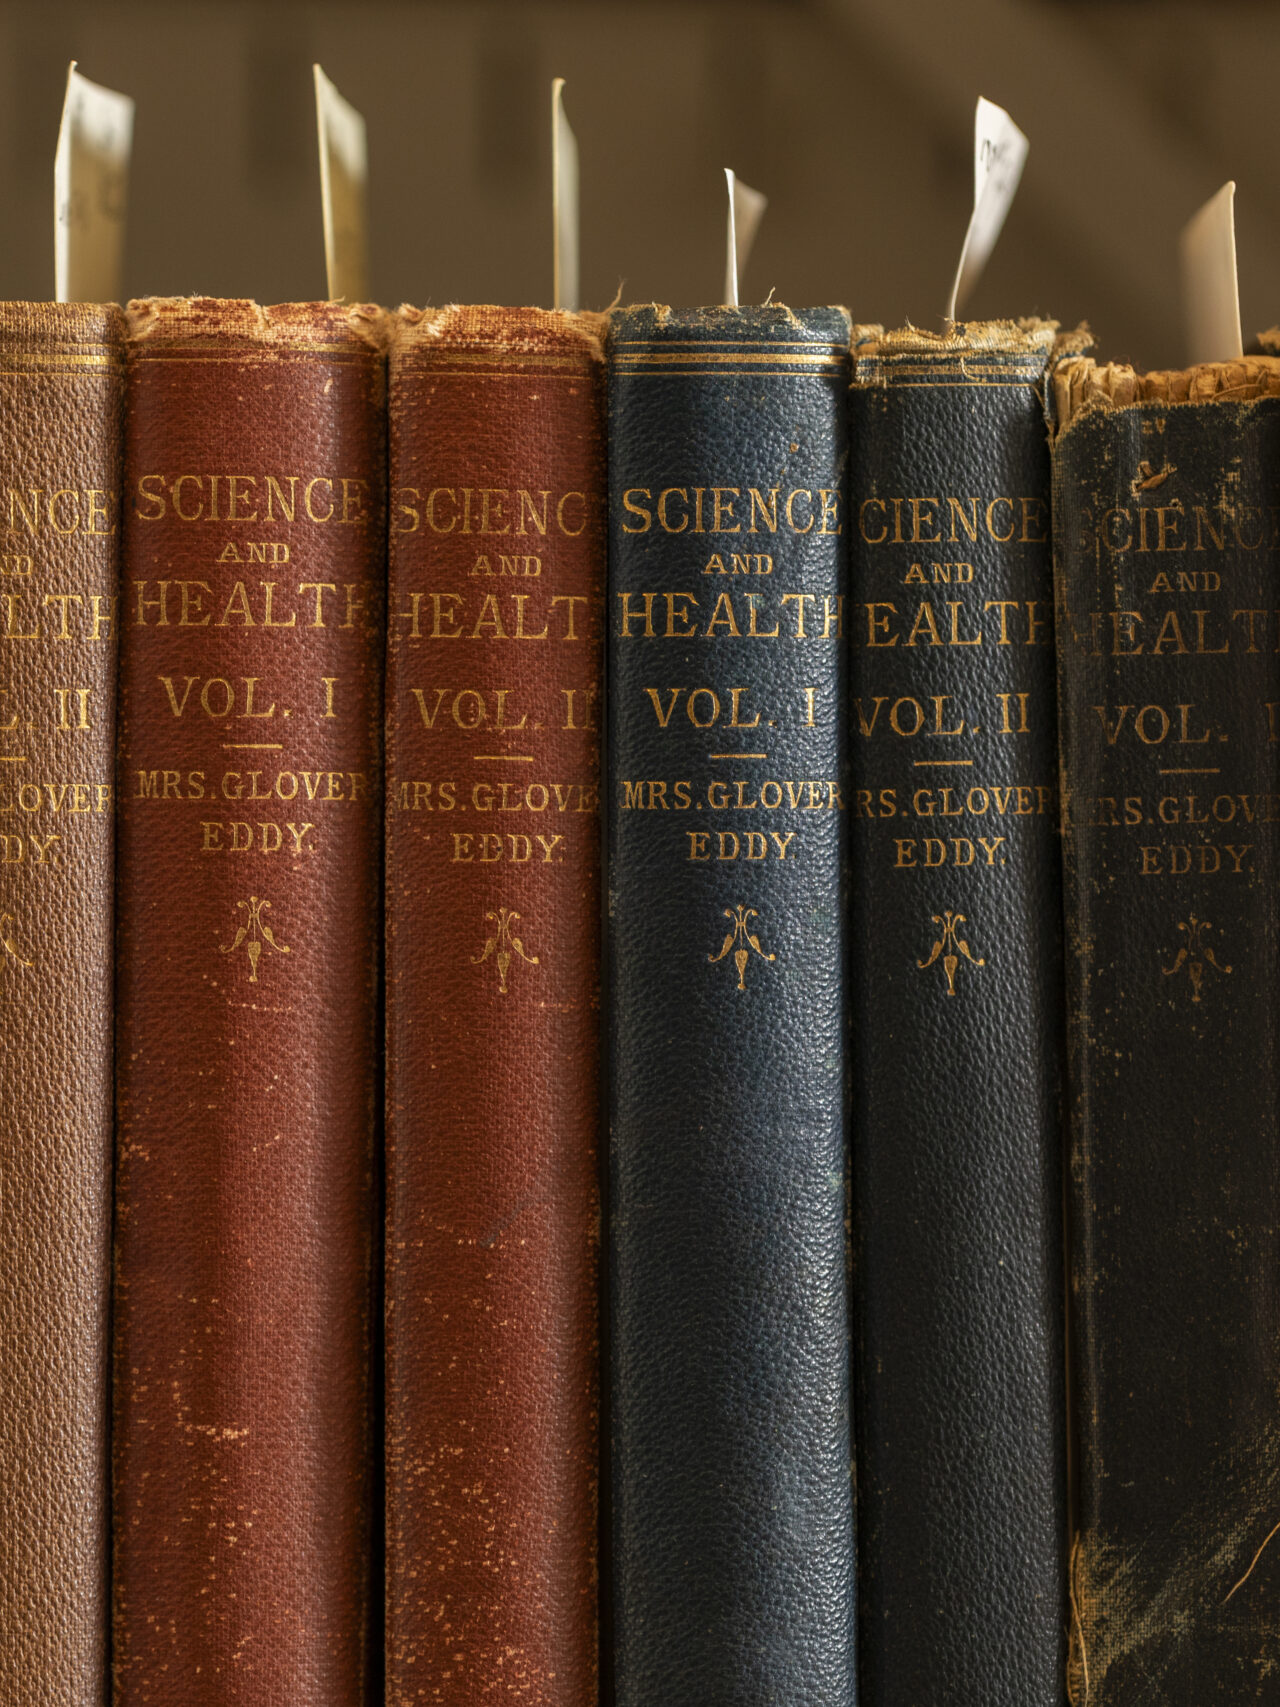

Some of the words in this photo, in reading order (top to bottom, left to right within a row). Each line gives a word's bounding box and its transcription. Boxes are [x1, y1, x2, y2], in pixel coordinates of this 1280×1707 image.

[137, 474, 368, 524] SCIENCE
[395, 487, 587, 536] SCIENC
[622, 487, 842, 534] SCIENCE
[858, 497, 1047, 543] CIENCE
[216, 542, 290, 563] AND
[467, 554, 542, 577] AND
[701, 553, 773, 575] AND
[902, 562, 974, 584] AND
[1148, 571, 1221, 593] AND
[394, 592, 588, 640] HEALT
[617, 592, 843, 639] HEALTH
[858, 601, 1052, 648] EALTH
[1066, 609, 1280, 657] HEALT
[54, 688, 90, 729] II
[157, 676, 293, 718] VOL.
[320, 677, 339, 718] I
[411, 688, 542, 730] VOL.
[561, 689, 596, 730] II
[643, 687, 777, 728] VOL.
[803, 688, 821, 727] I
[855, 695, 980, 737] VOL.
[995, 693, 1030, 733] II
[1093, 704, 1229, 744] VOL.
[855, 786, 1052, 818] RS.GLOVER
[199, 821, 317, 852] EDDY.
[894, 837, 1007, 867] EDDY.
[1140, 845, 1255, 875] EDDY.
